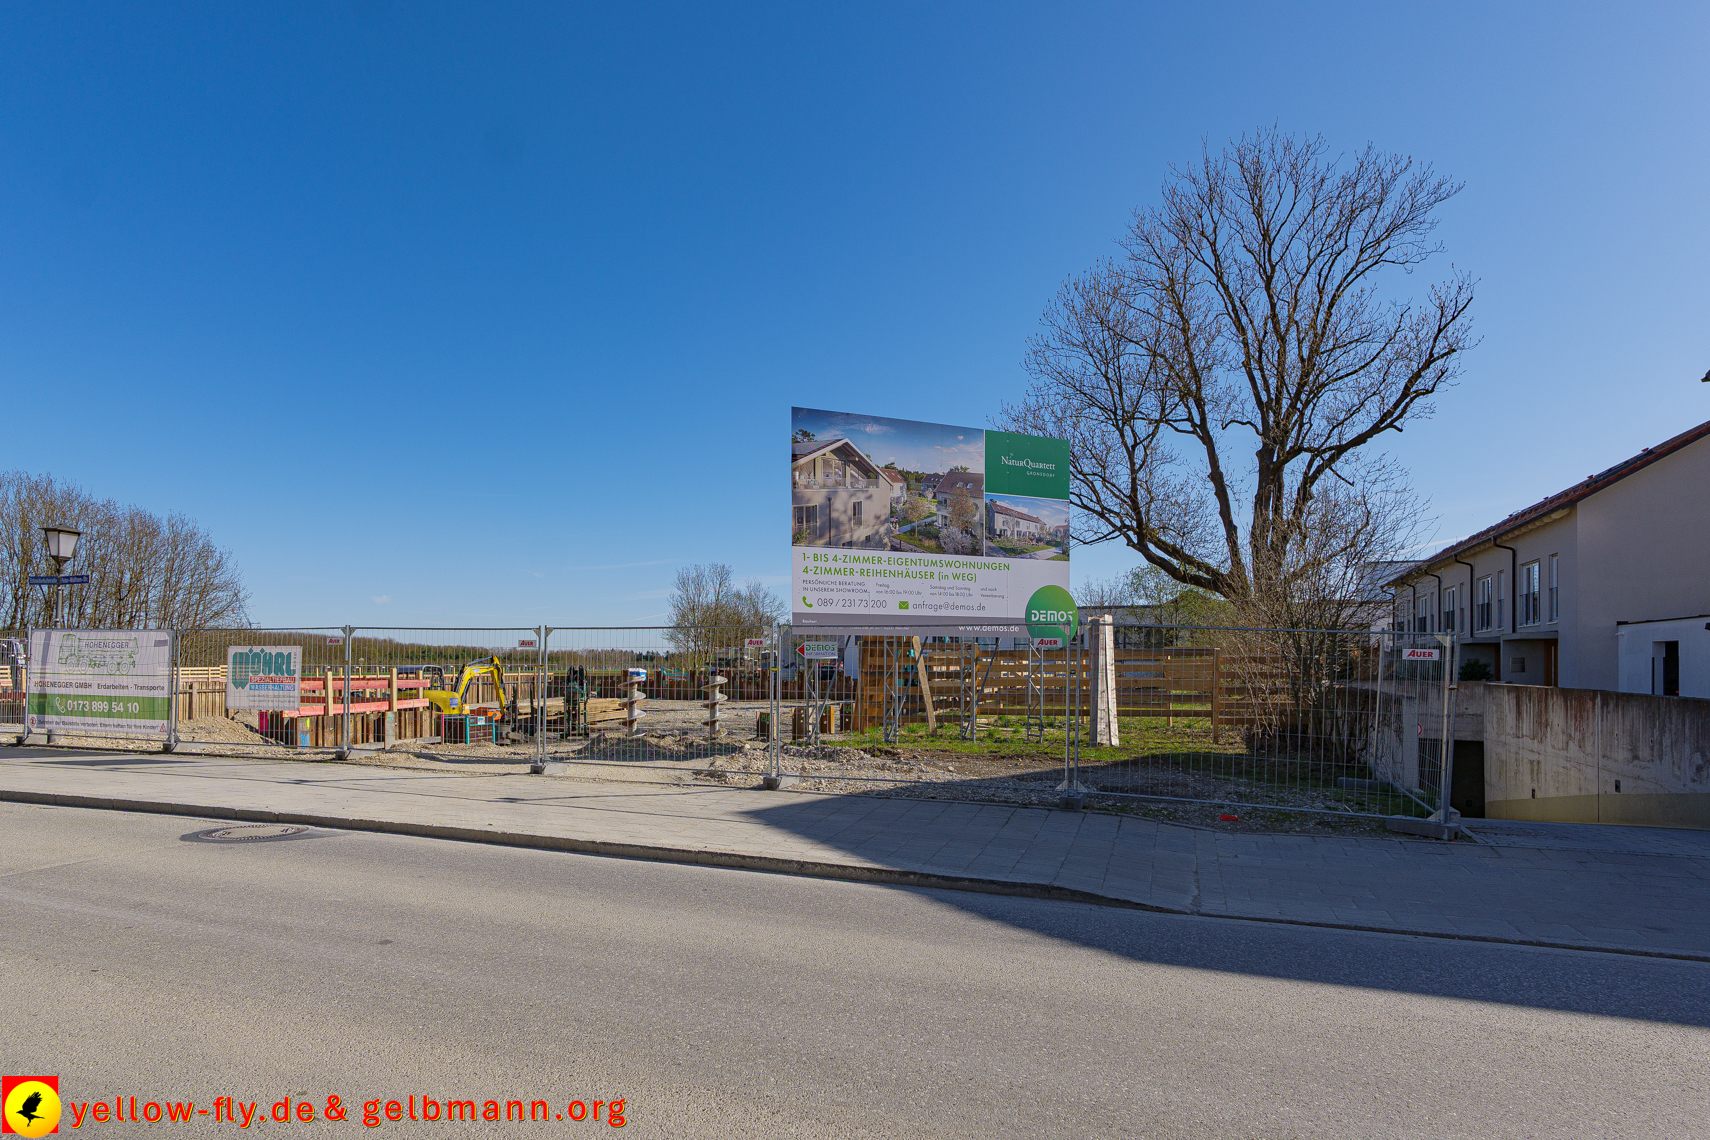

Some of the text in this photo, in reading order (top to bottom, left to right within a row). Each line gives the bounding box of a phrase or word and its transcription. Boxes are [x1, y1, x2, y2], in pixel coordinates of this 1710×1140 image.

[813, 553, 829, 562] BIS
[802, 565, 977, 583] 4-ZIMMER-REIHENHÄUSER (in WEG)
[817, 598, 834, 607] 089
[912, 601, 986, 612] anfrage@demos.de
[84, 641, 129, 649] HOHENEGGER
[1037, 638, 1058, 646] AUER
[1407, 649, 1434, 658] AUER
[34, 680, 73, 688] HOHENEGGER
[133, 684, 165, 692] Transporte
[66, 699, 140, 713] 0173 899 54 10
